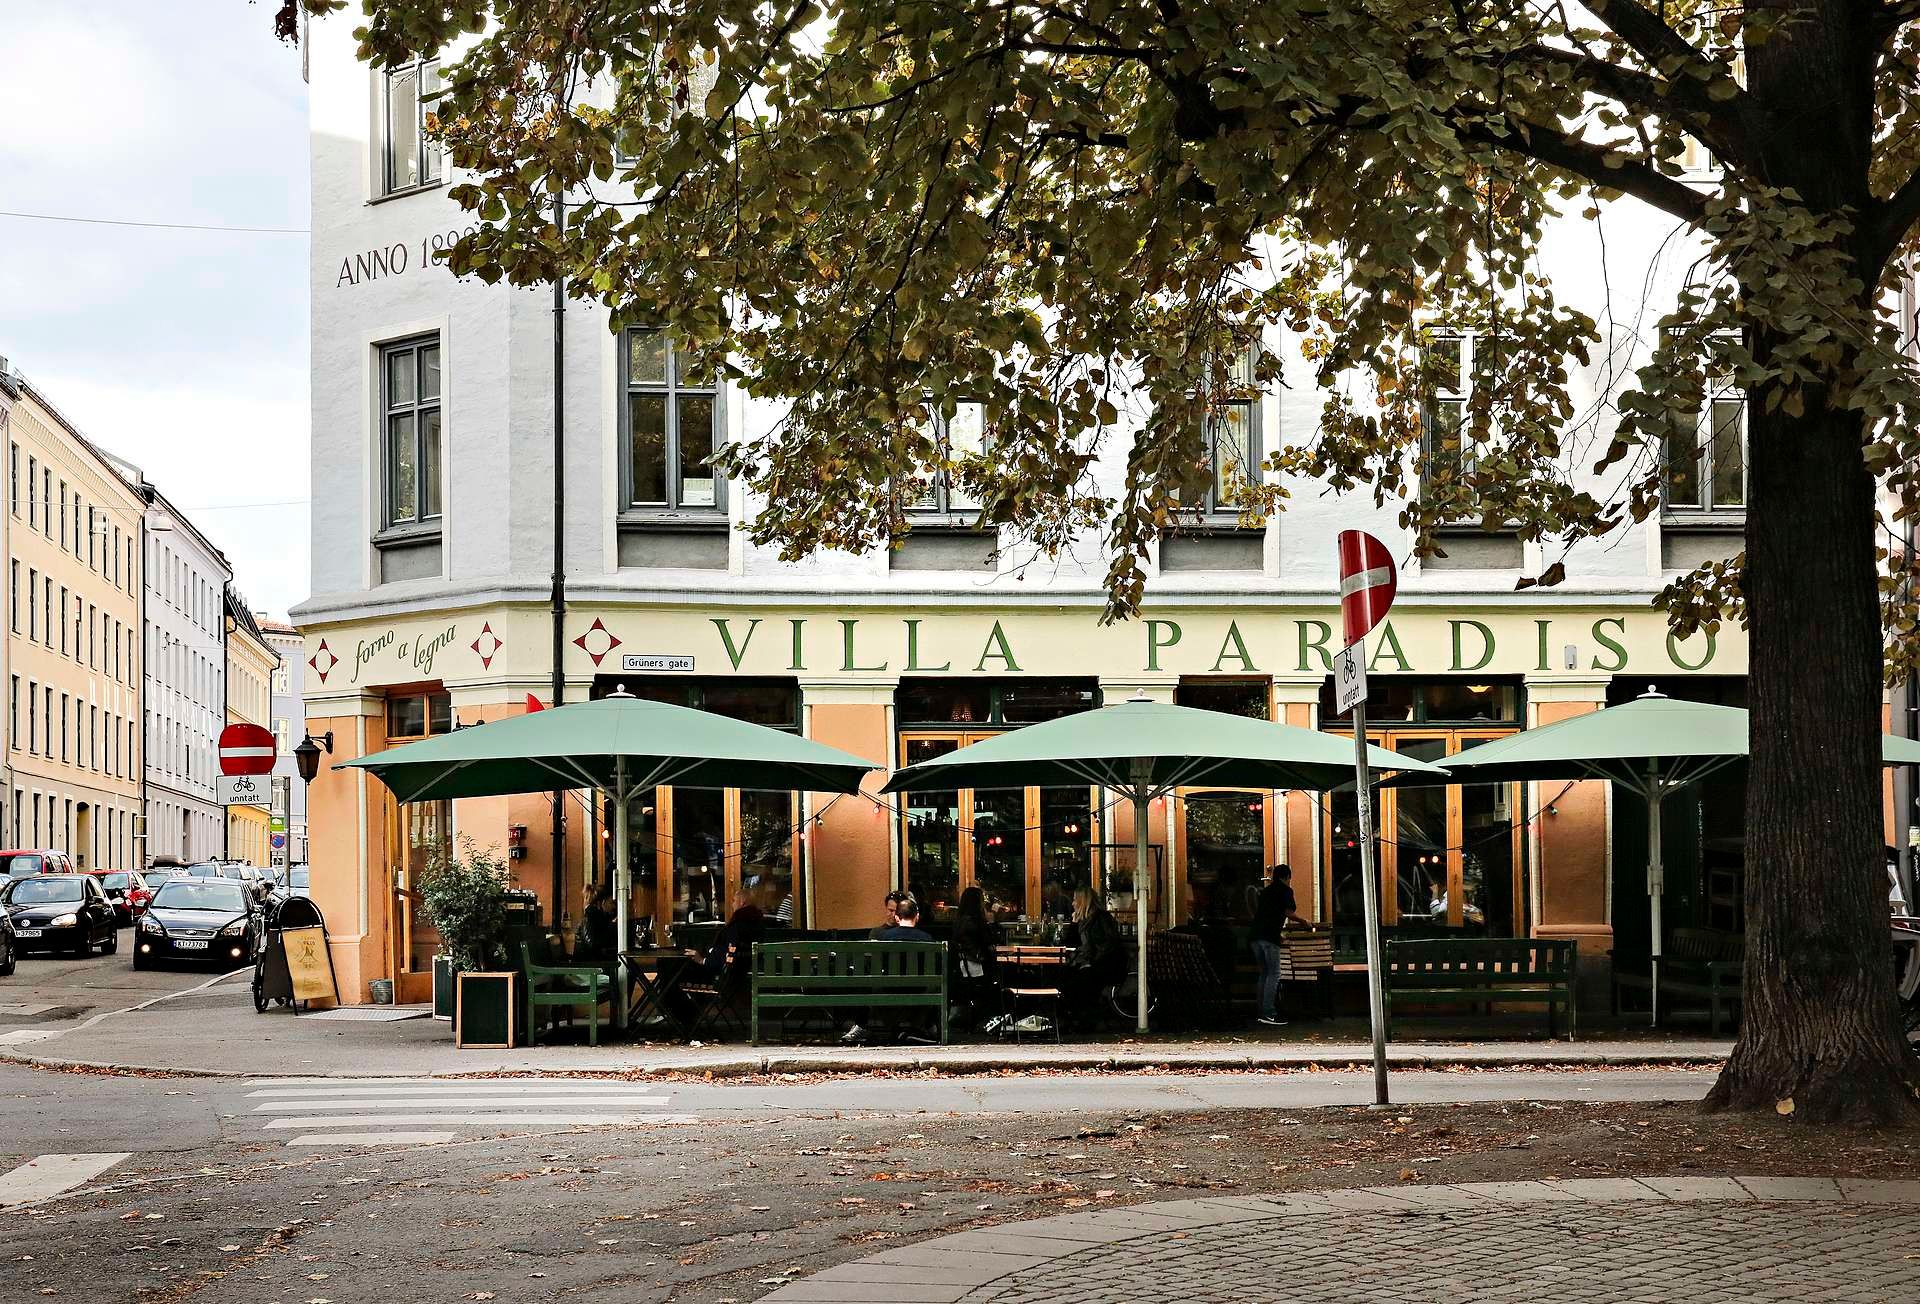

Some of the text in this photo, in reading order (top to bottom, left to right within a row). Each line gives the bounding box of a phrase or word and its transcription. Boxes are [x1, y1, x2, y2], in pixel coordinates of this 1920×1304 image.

[337, 243, 408, 288] ANNO
[350, 624, 457, 684] forno a legna
[709, 618, 1717, 673] VILLA PARADISO
[628, 658, 689, 670] Grüners gate
[1342, 683, 1360, 705] unntatt
[229, 794, 260, 803] unntatt
